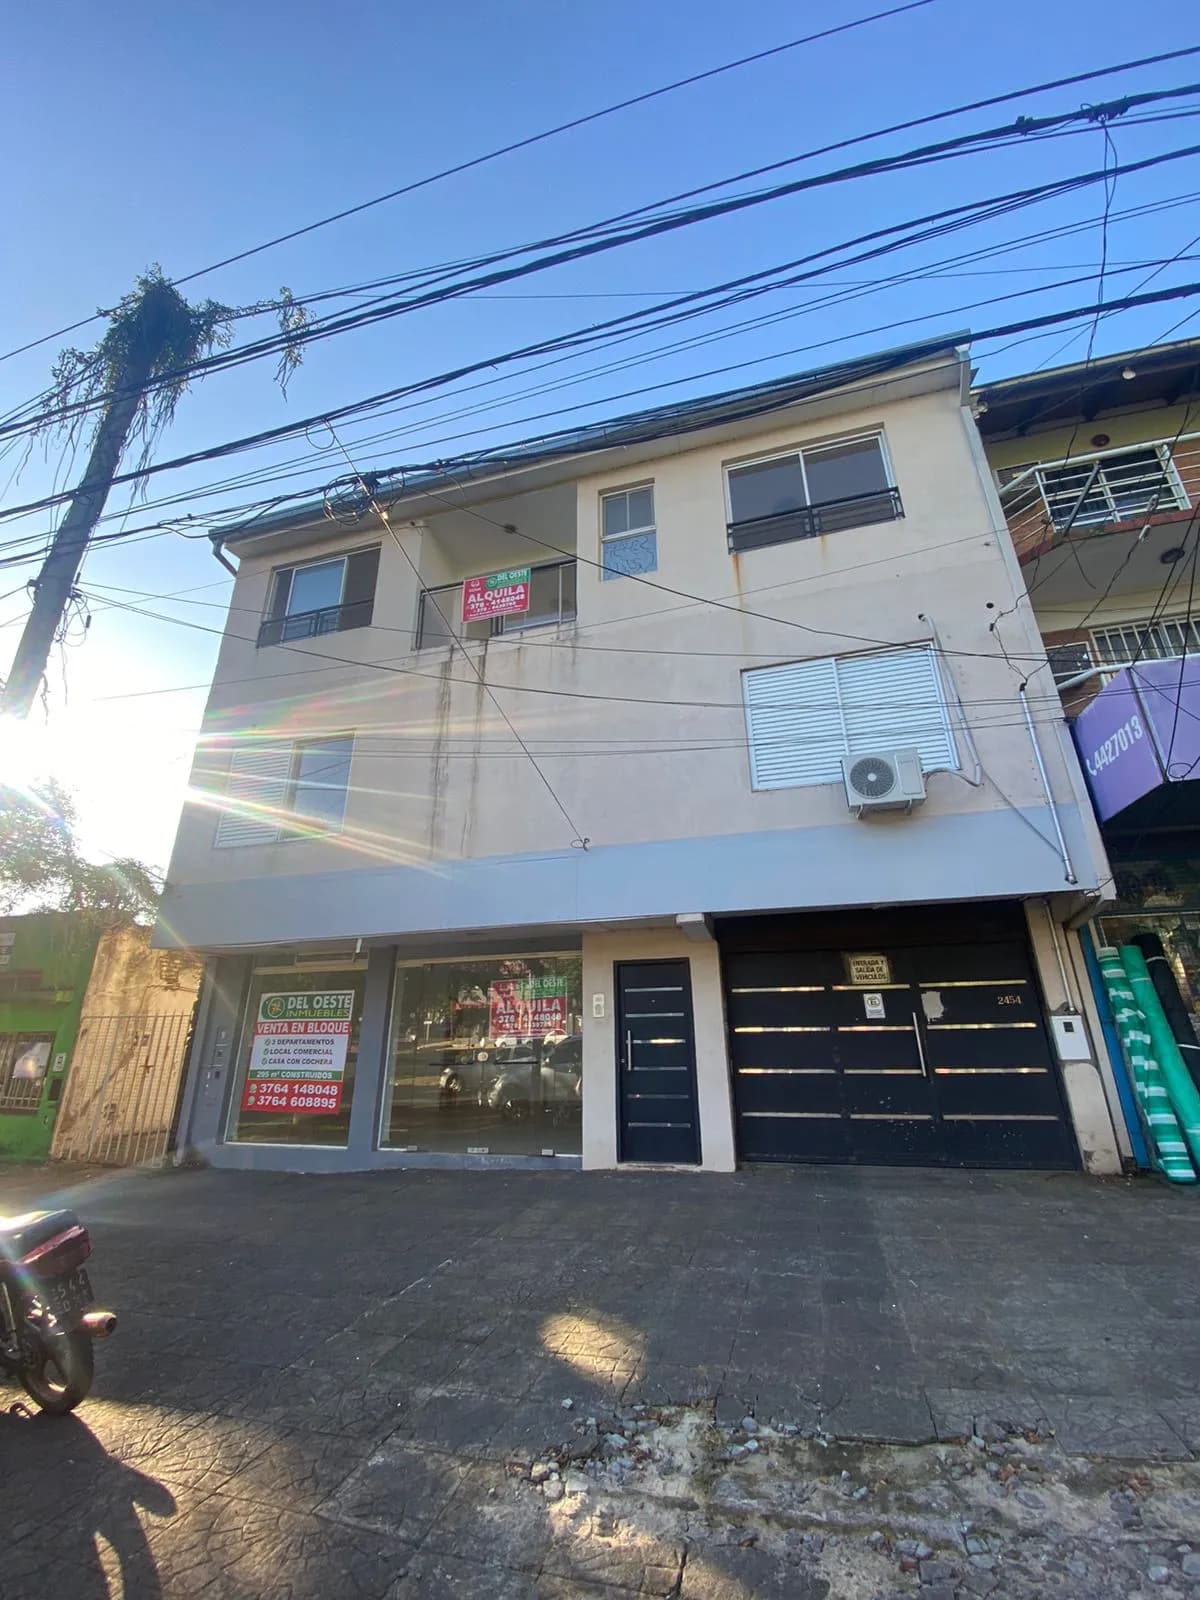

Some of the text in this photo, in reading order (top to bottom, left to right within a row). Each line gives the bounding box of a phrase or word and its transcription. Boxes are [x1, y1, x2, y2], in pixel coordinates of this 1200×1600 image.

[468, 584, 524, 604] ALQUILA
[1094, 714, 1144, 772] 4427013
[287, 995, 352, 1009] DEL OESTE
[496, 998, 561, 1014] ALQUILA
[997, 996, 1022, 1005] 2454
[286, 1008, 350, 1018] INMUEBLES
[256, 1022, 349, 1034] VENTA EN BLOQUE
[281, 1071, 333, 1079] CONSTRUIDOS
[259, 1083, 338, 1096] 3764 148048
[256, 1096, 337, 1108] 3764 608895
